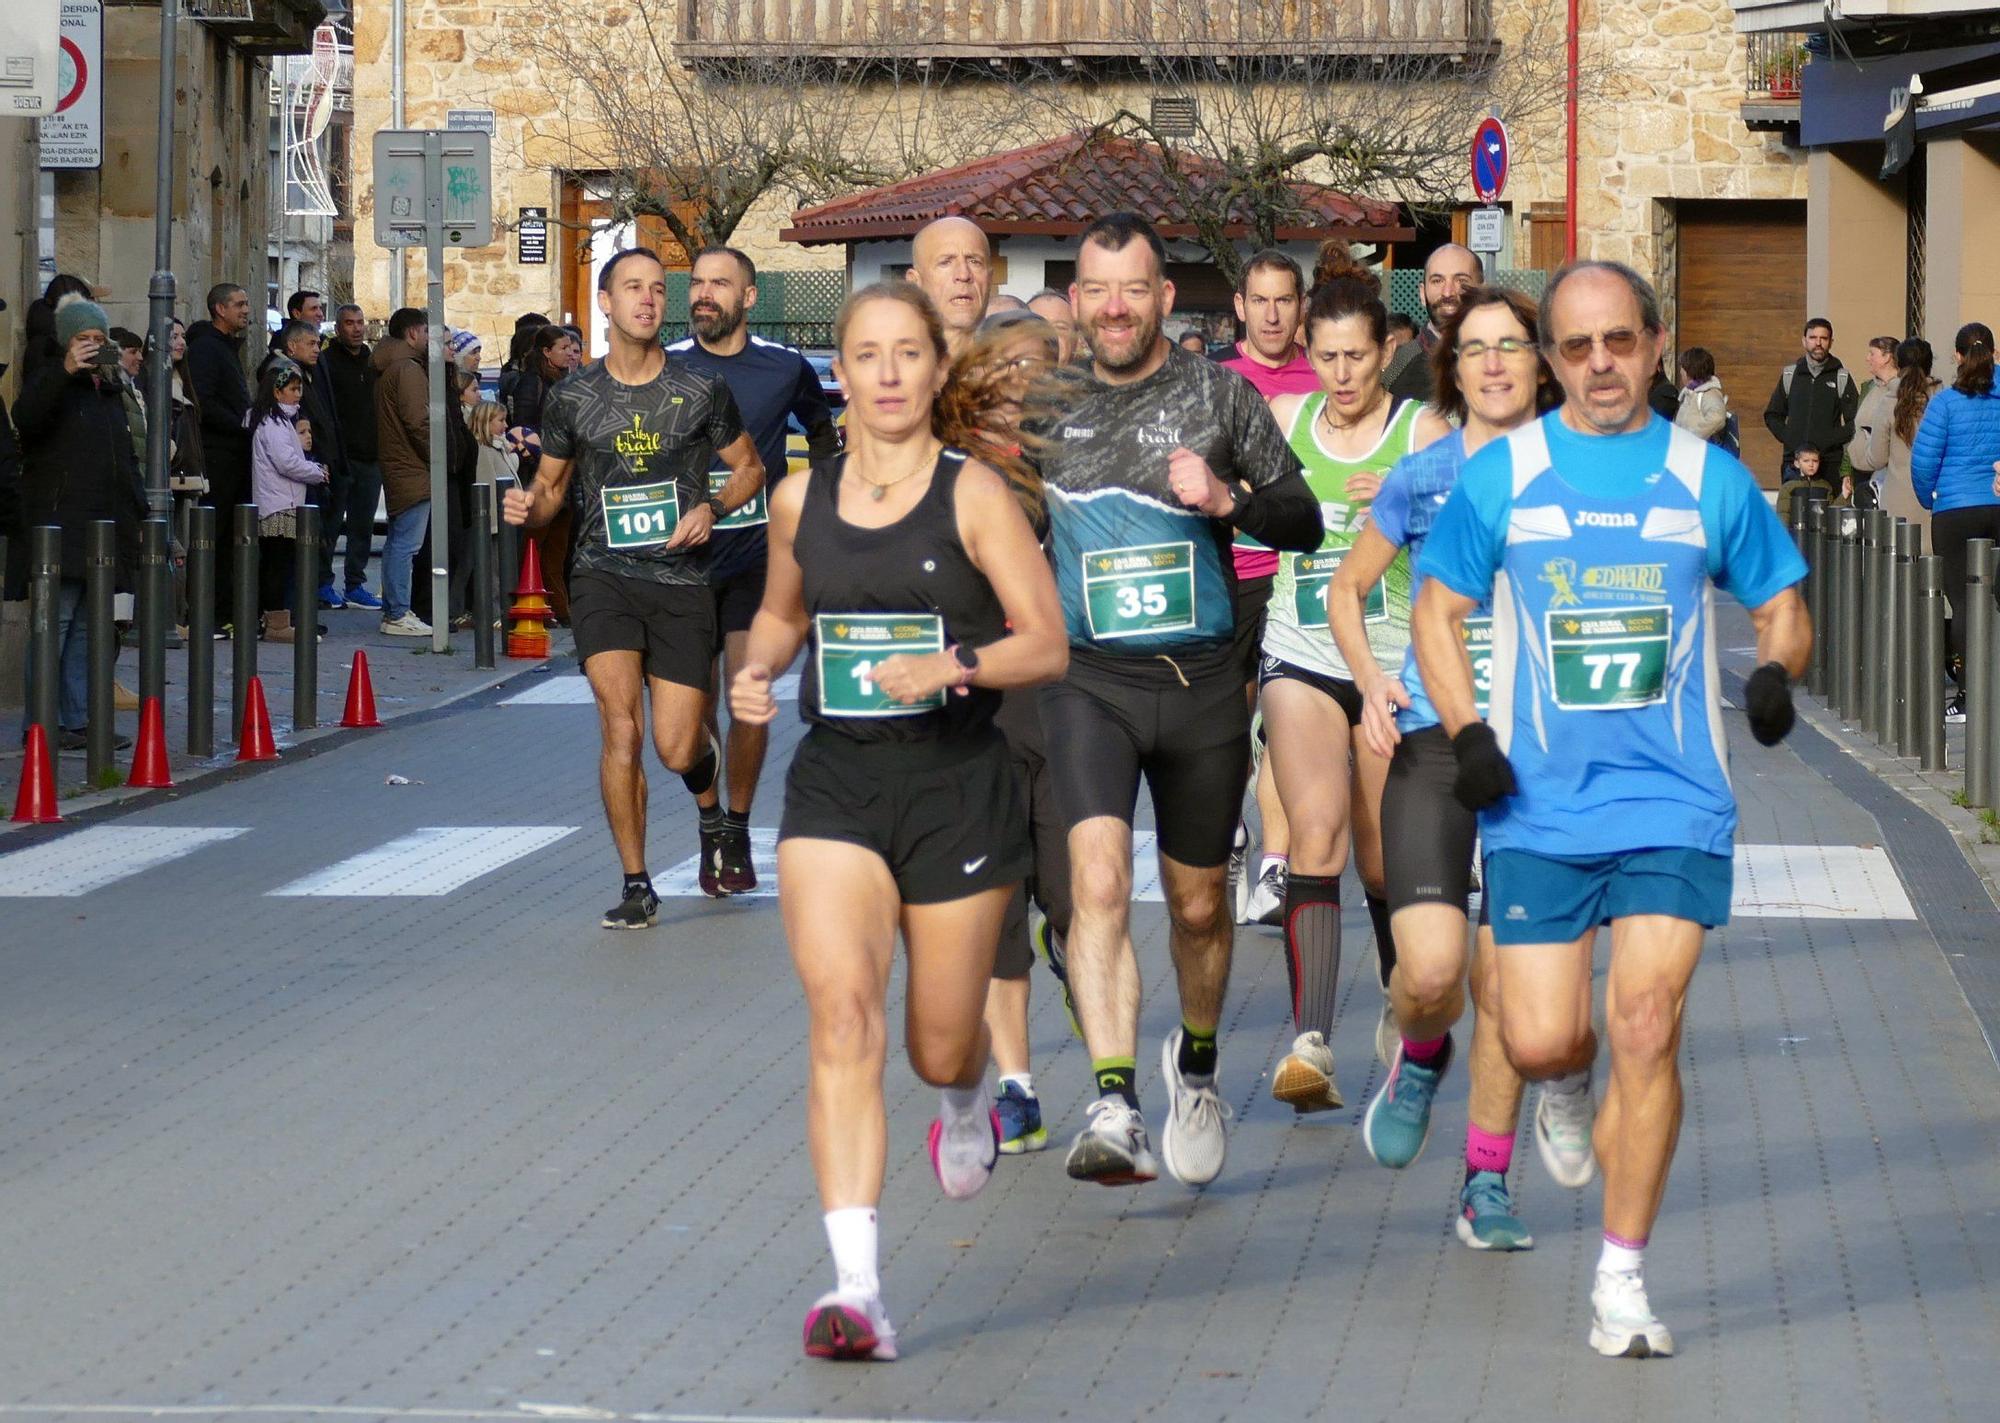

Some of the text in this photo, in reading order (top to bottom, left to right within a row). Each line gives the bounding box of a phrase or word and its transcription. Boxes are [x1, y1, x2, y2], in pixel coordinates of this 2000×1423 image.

[61, 5, 98, 13] DERDIA
[618, 509, 666, 535] 101
[1595, 566, 1662, 590] EDWARD
[1116, 583, 1167, 618] 35
[1582, 653, 1641, 689] 77
